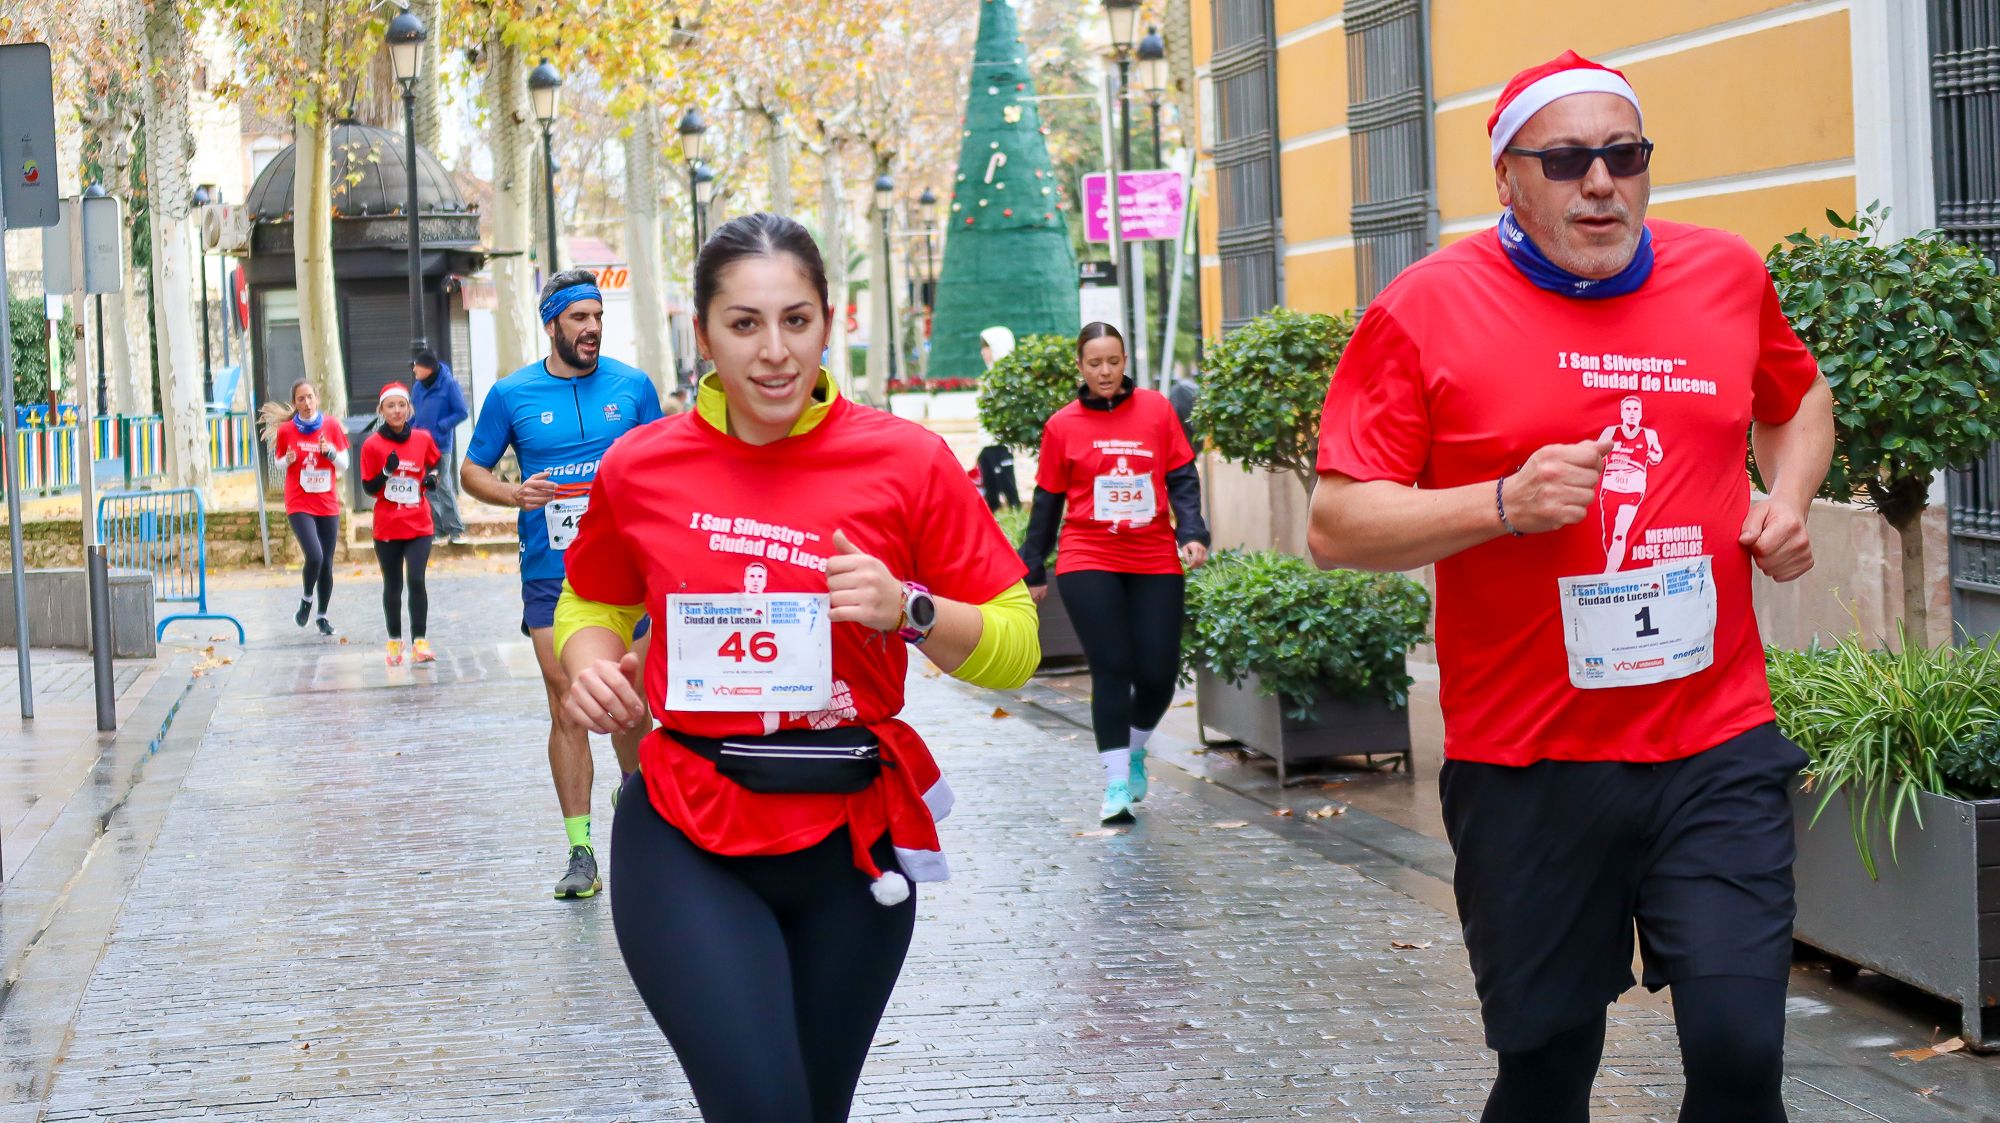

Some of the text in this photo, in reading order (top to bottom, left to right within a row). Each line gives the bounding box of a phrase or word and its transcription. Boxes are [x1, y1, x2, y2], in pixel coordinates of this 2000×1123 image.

[1558, 352, 1567, 368] I
[1570, 352, 1600, 370] San
[1602, 354, 1673, 374] Silvestre
[1582, 372, 1716, 396] Ciudad de Lucena
[544, 460, 600, 476] enerpl
[1109, 490, 1143, 502] 334
[690, 512, 701, 529] I
[701, 514, 732, 532] San
[732, 517, 805, 546] Silvestre
[1645, 526, 1702, 544] MEMORIAL
[709, 533, 828, 572] Ciudad de Luce
[1632, 540, 1702, 560] JOSE CARLOS
[1578, 588, 1596, 596] San
[1598, 584, 1639, 596] Silvestre
[1578, 590, 1660, 606] Ciudad de Lucena
[685, 606, 701, 614] San
[704, 606, 742, 614] Silvestre
[684, 616, 762, 624] Ciudad de Lucena
[1634, 606, 1660, 638] 1
[718, 632, 778, 662] 46
[1672, 645, 1706, 660] enerplus
[771, 684, 813, 693] enerplus
